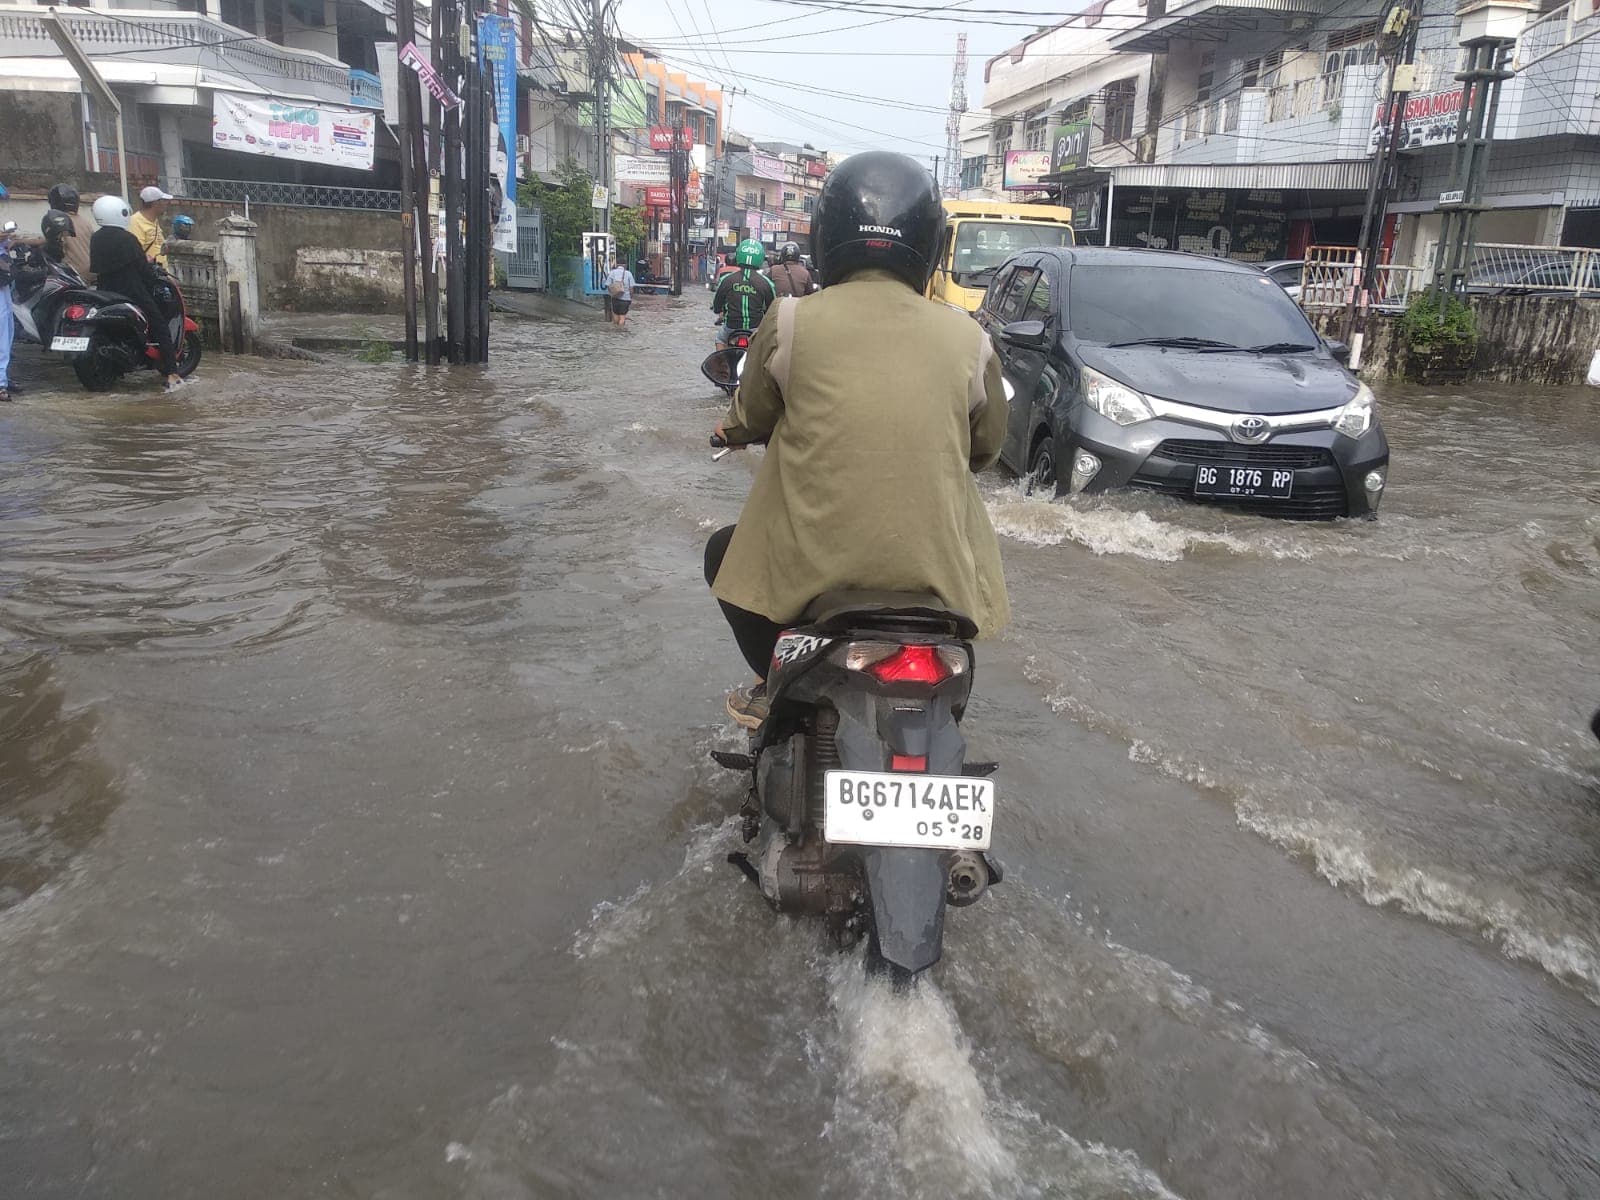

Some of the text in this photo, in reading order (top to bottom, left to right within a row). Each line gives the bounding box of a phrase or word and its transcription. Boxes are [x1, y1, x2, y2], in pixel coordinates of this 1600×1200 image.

[268, 120, 320, 143] HEPPI
[858, 225, 902, 238] HONDA
[741, 245, 760, 255] Grab
[732, 283, 757, 294] Grab
[1198, 467, 1290, 488] BG 1876 RP
